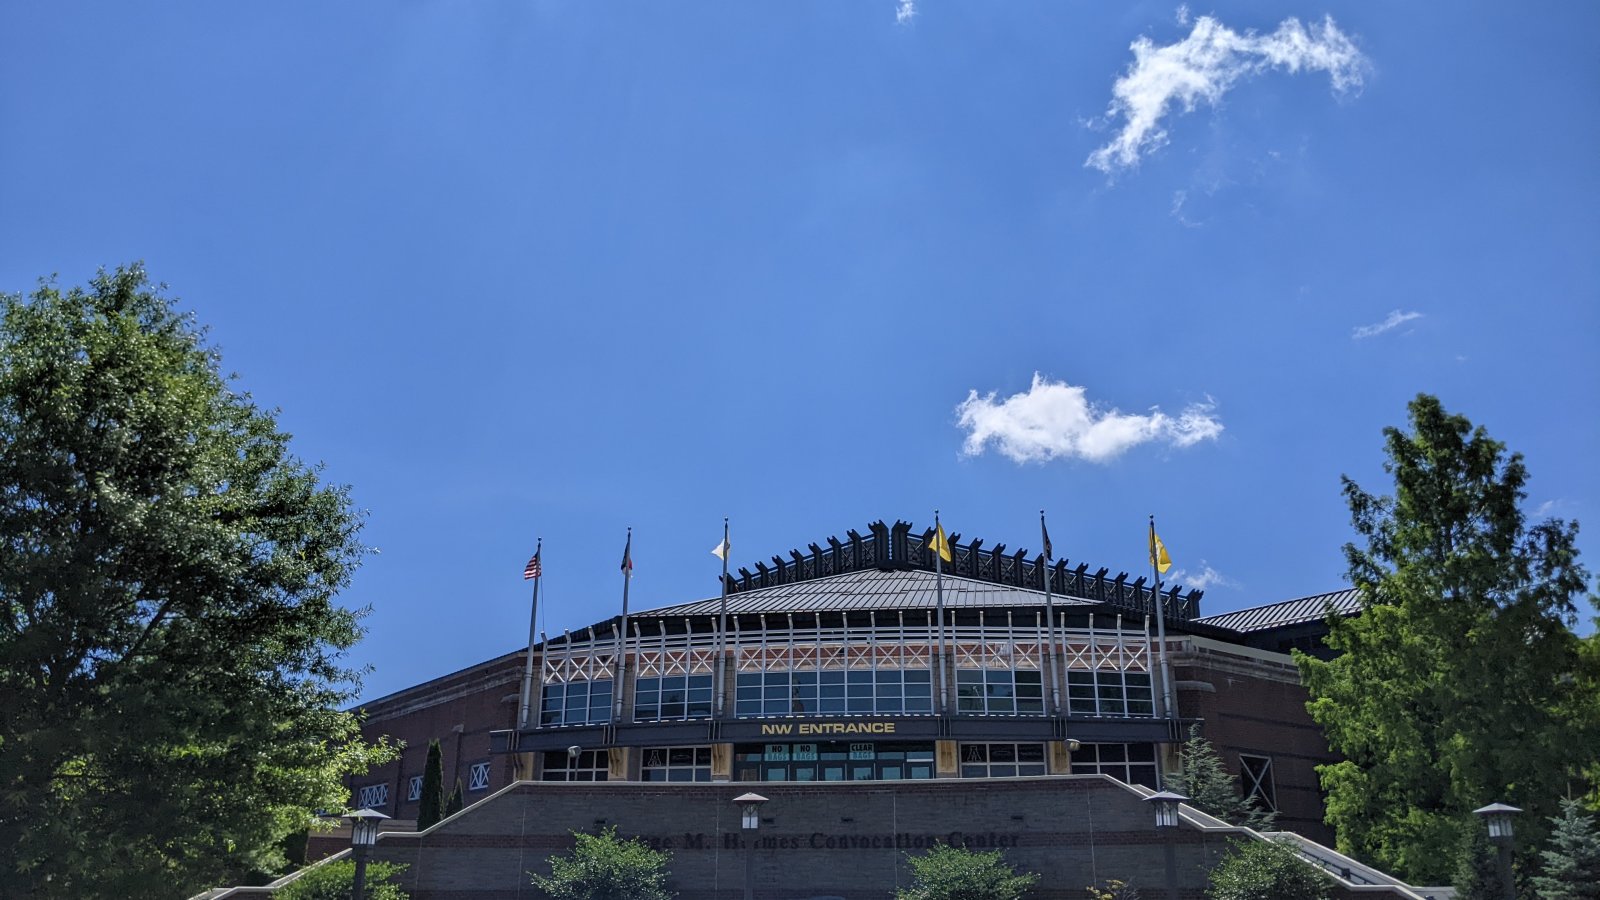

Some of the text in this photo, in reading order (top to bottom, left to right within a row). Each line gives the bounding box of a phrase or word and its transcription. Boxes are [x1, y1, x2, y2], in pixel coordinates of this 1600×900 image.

[762, 722, 895, 735] NW ENTRANCE
[851, 744, 872, 752] CLEAR
[724, 833, 799, 849] Hmes
[809, 832, 936, 849] Convocation
[949, 831, 1018, 848] Center
